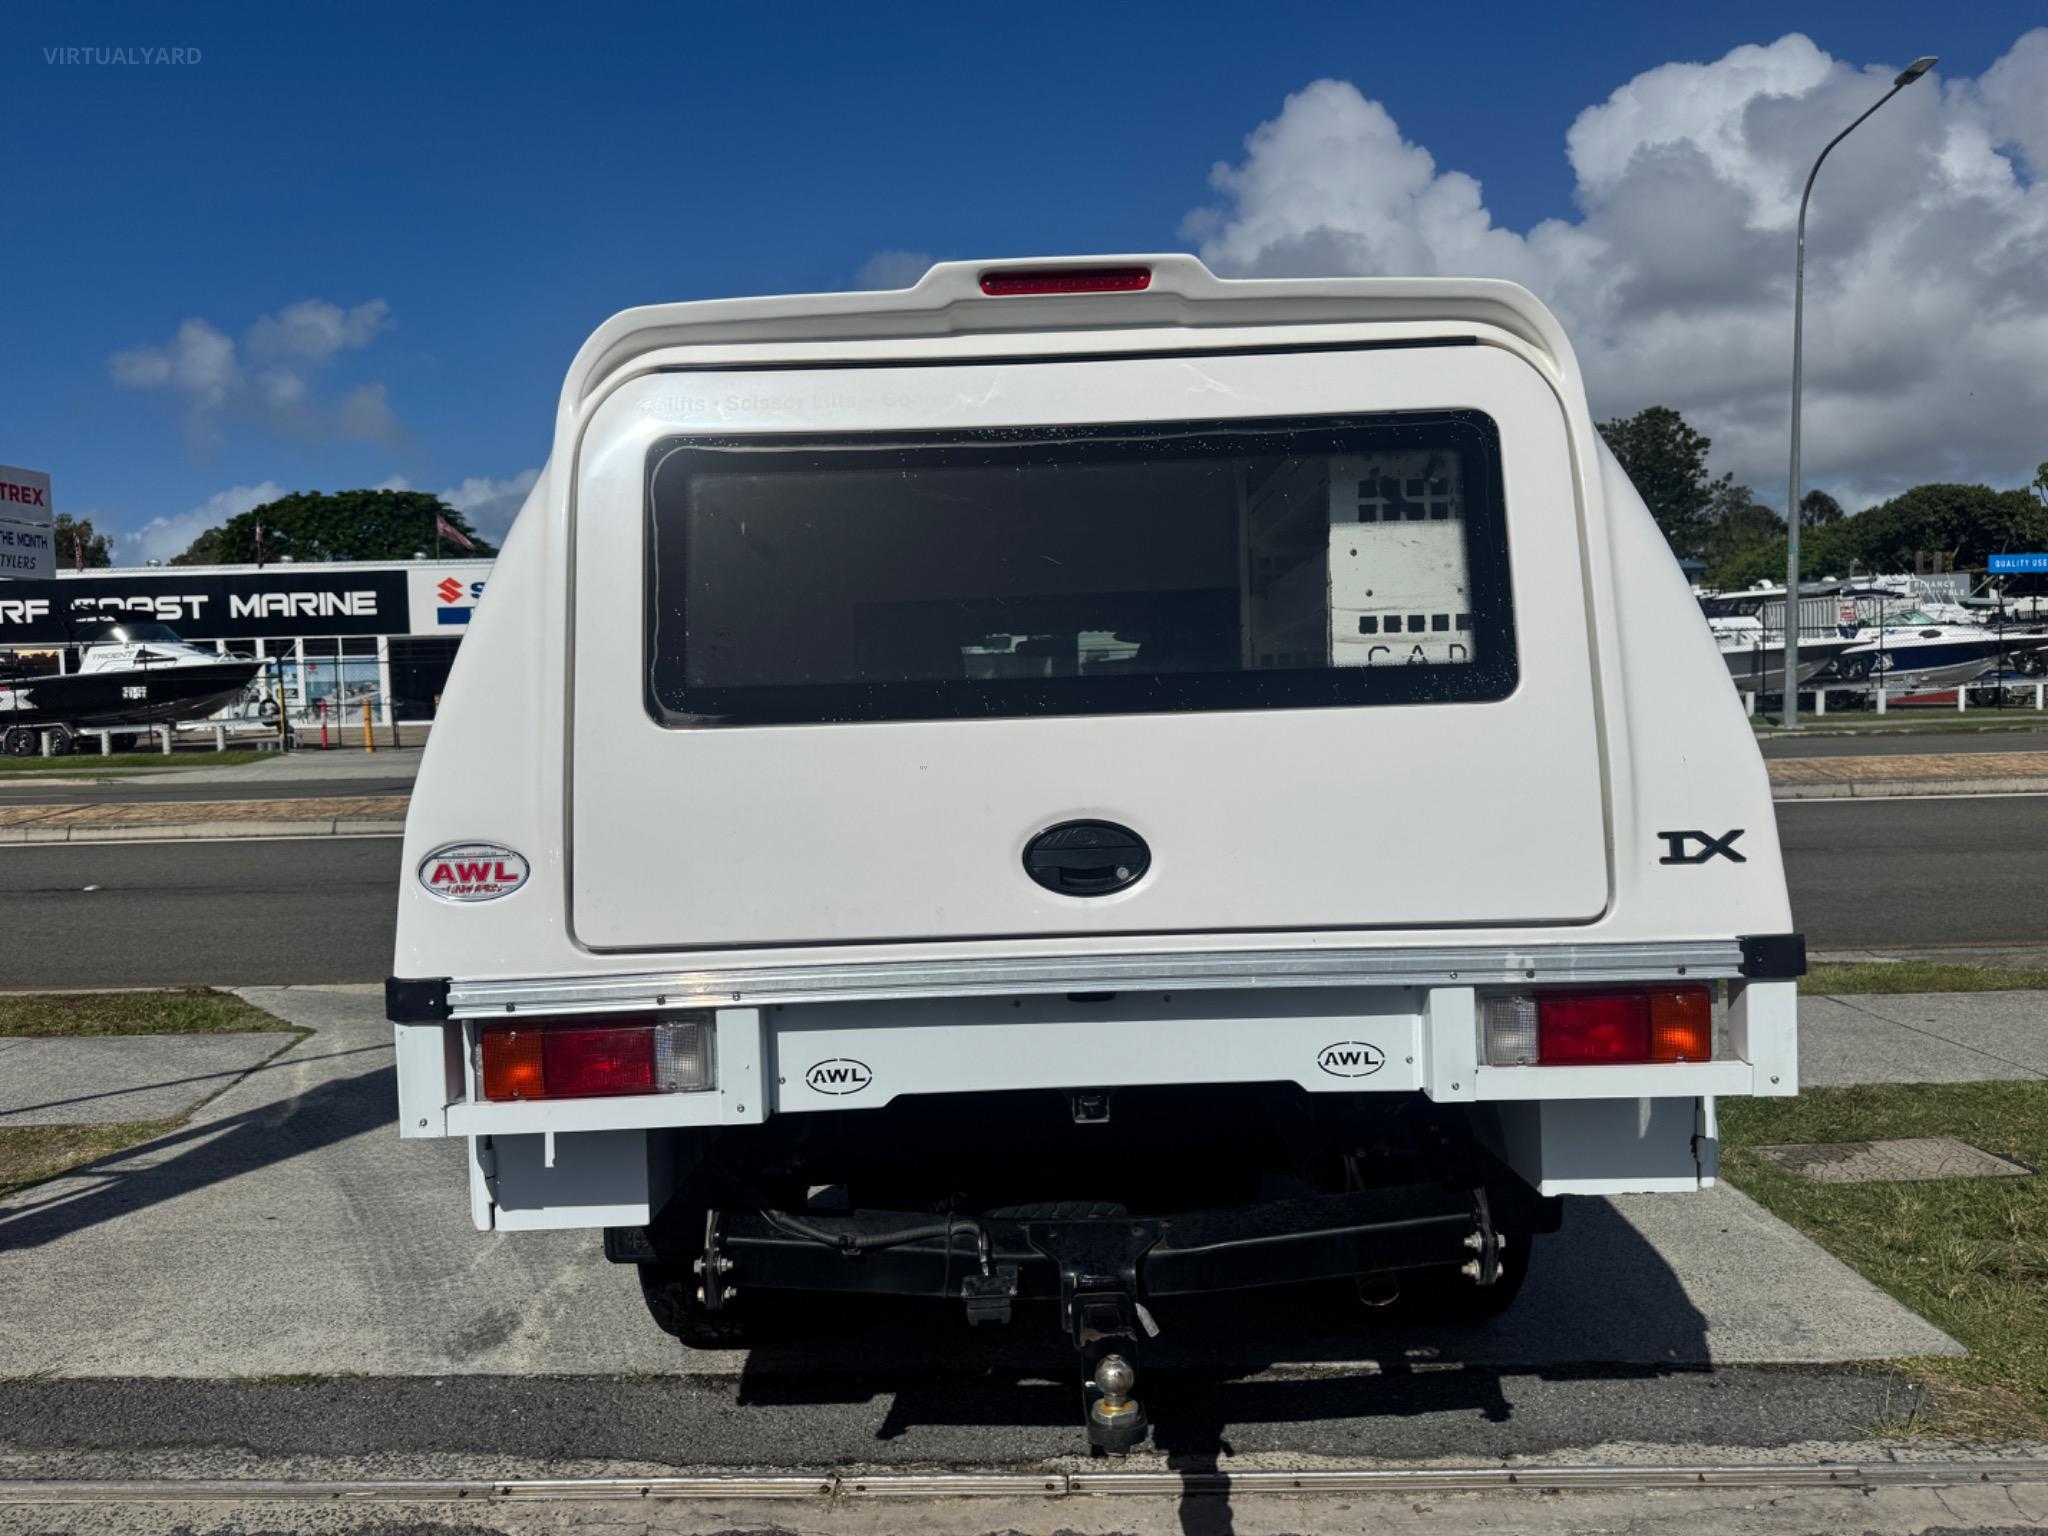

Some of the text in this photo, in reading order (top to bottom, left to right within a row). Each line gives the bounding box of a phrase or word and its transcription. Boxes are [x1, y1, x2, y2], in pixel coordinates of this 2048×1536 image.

[17, 531, 48, 551] MONTH
[1995, 559, 2029, 568] QUALITY
[229, 591, 378, 619] MARINE
[430, 861, 519, 885] AWL
[1323, 1051, 1379, 1066] AWL
[812, 1068, 866, 1084] AWL
